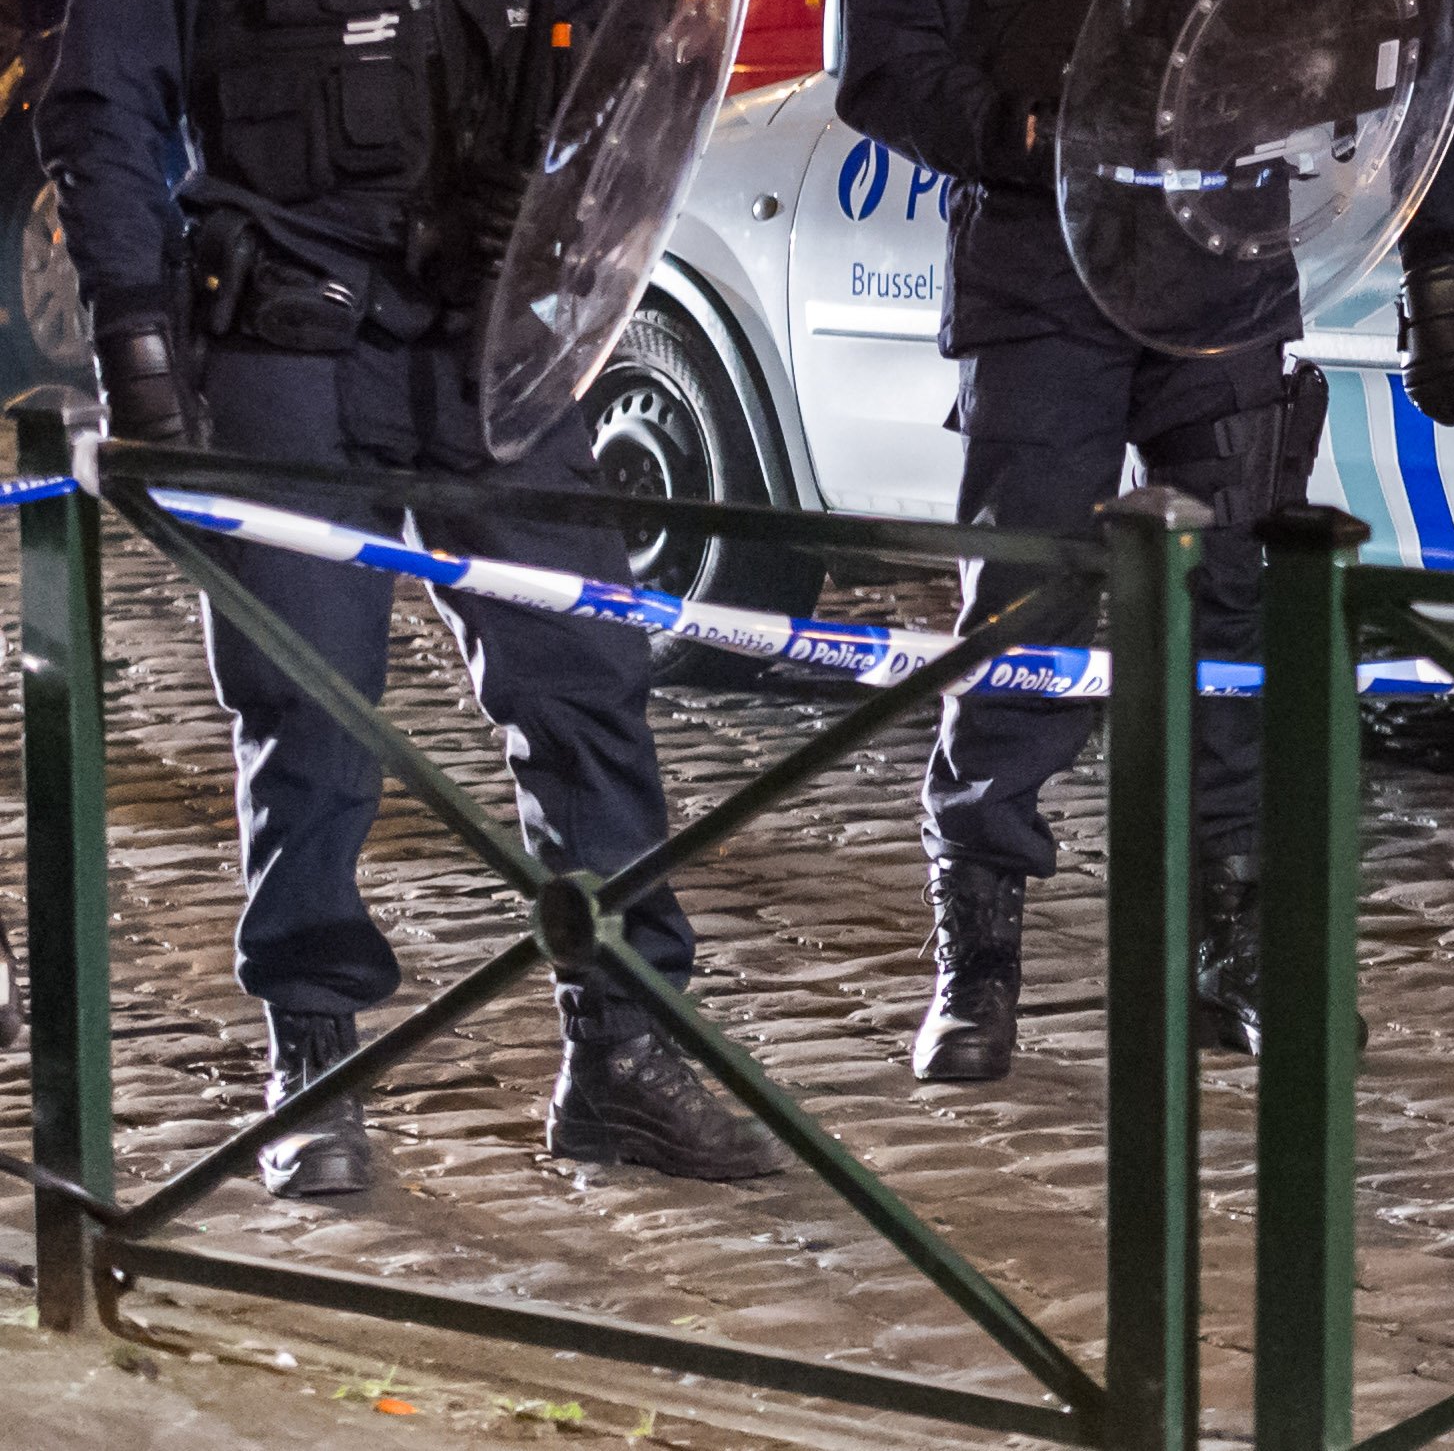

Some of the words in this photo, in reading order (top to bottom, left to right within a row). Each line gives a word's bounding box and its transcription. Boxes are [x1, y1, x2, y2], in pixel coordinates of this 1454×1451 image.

[852, 262, 943, 300] Brussel-
[810, 641, 877, 671] Police
[1008, 665, 1073, 694] Police
